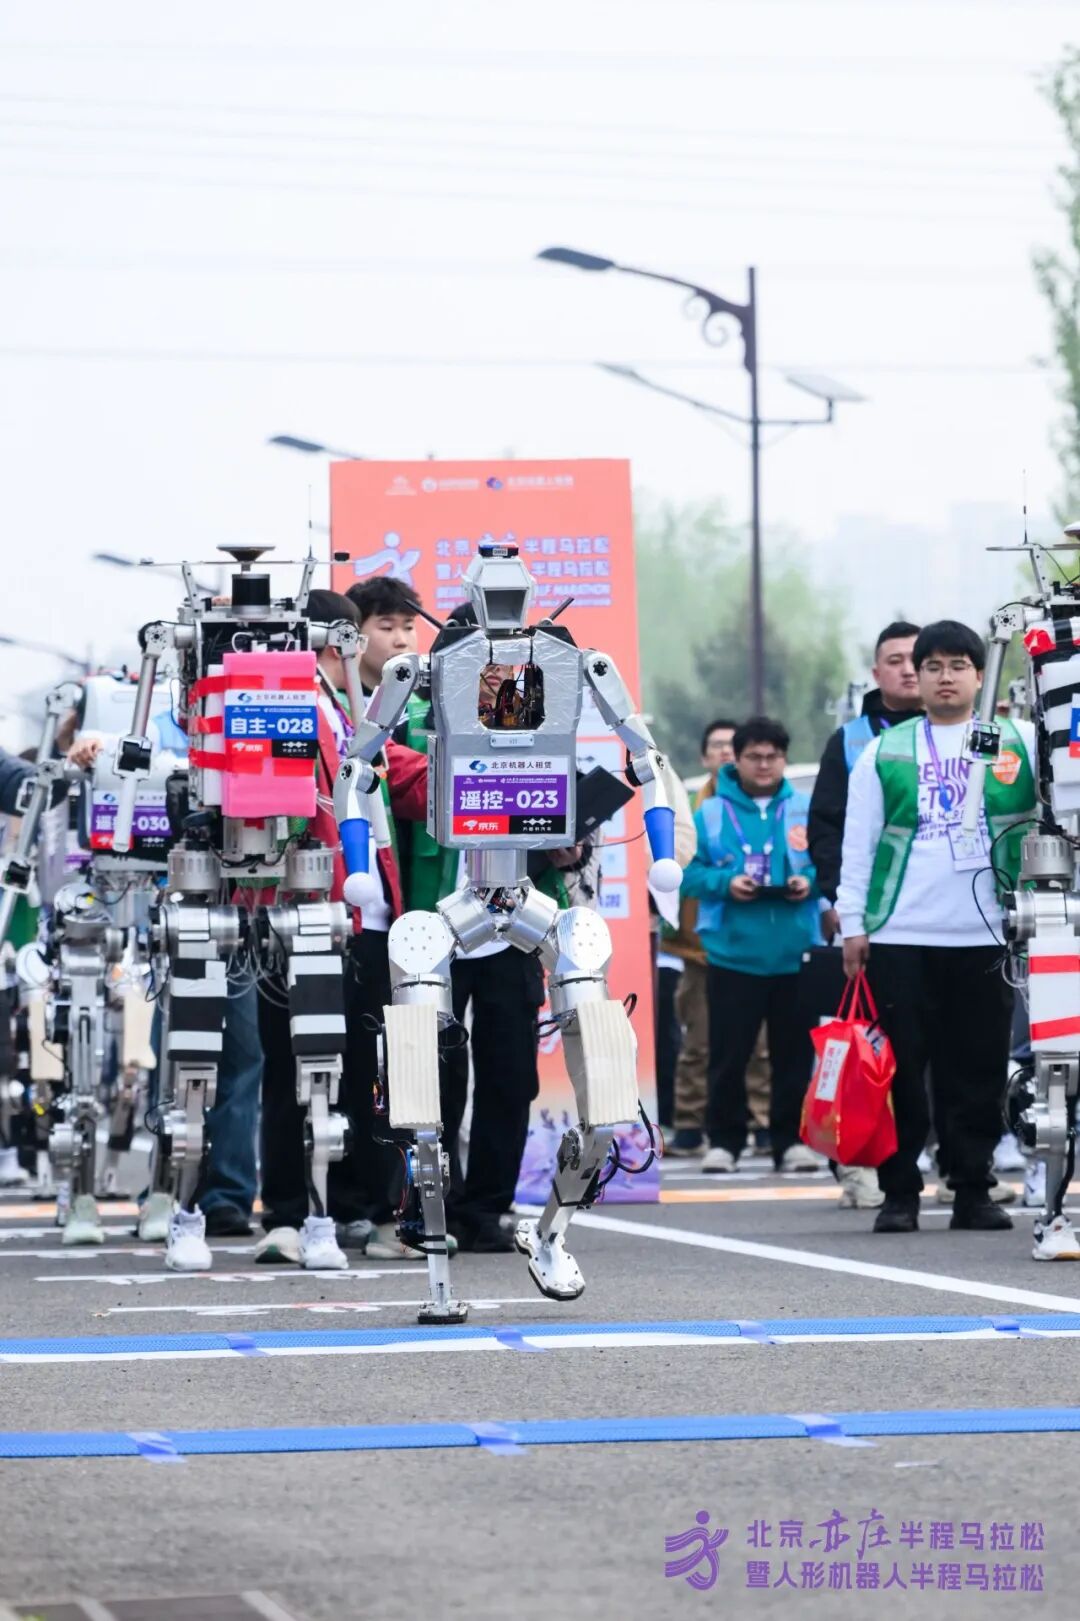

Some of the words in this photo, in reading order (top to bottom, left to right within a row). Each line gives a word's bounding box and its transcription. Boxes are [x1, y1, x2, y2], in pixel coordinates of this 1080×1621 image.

[231, 717, 314, 735] 自主-028
[491, 761, 552, 770] 北京机器人租赁
[460, 790, 558, 810] 遥控-023
[478, 822, 499, 831] 京东
